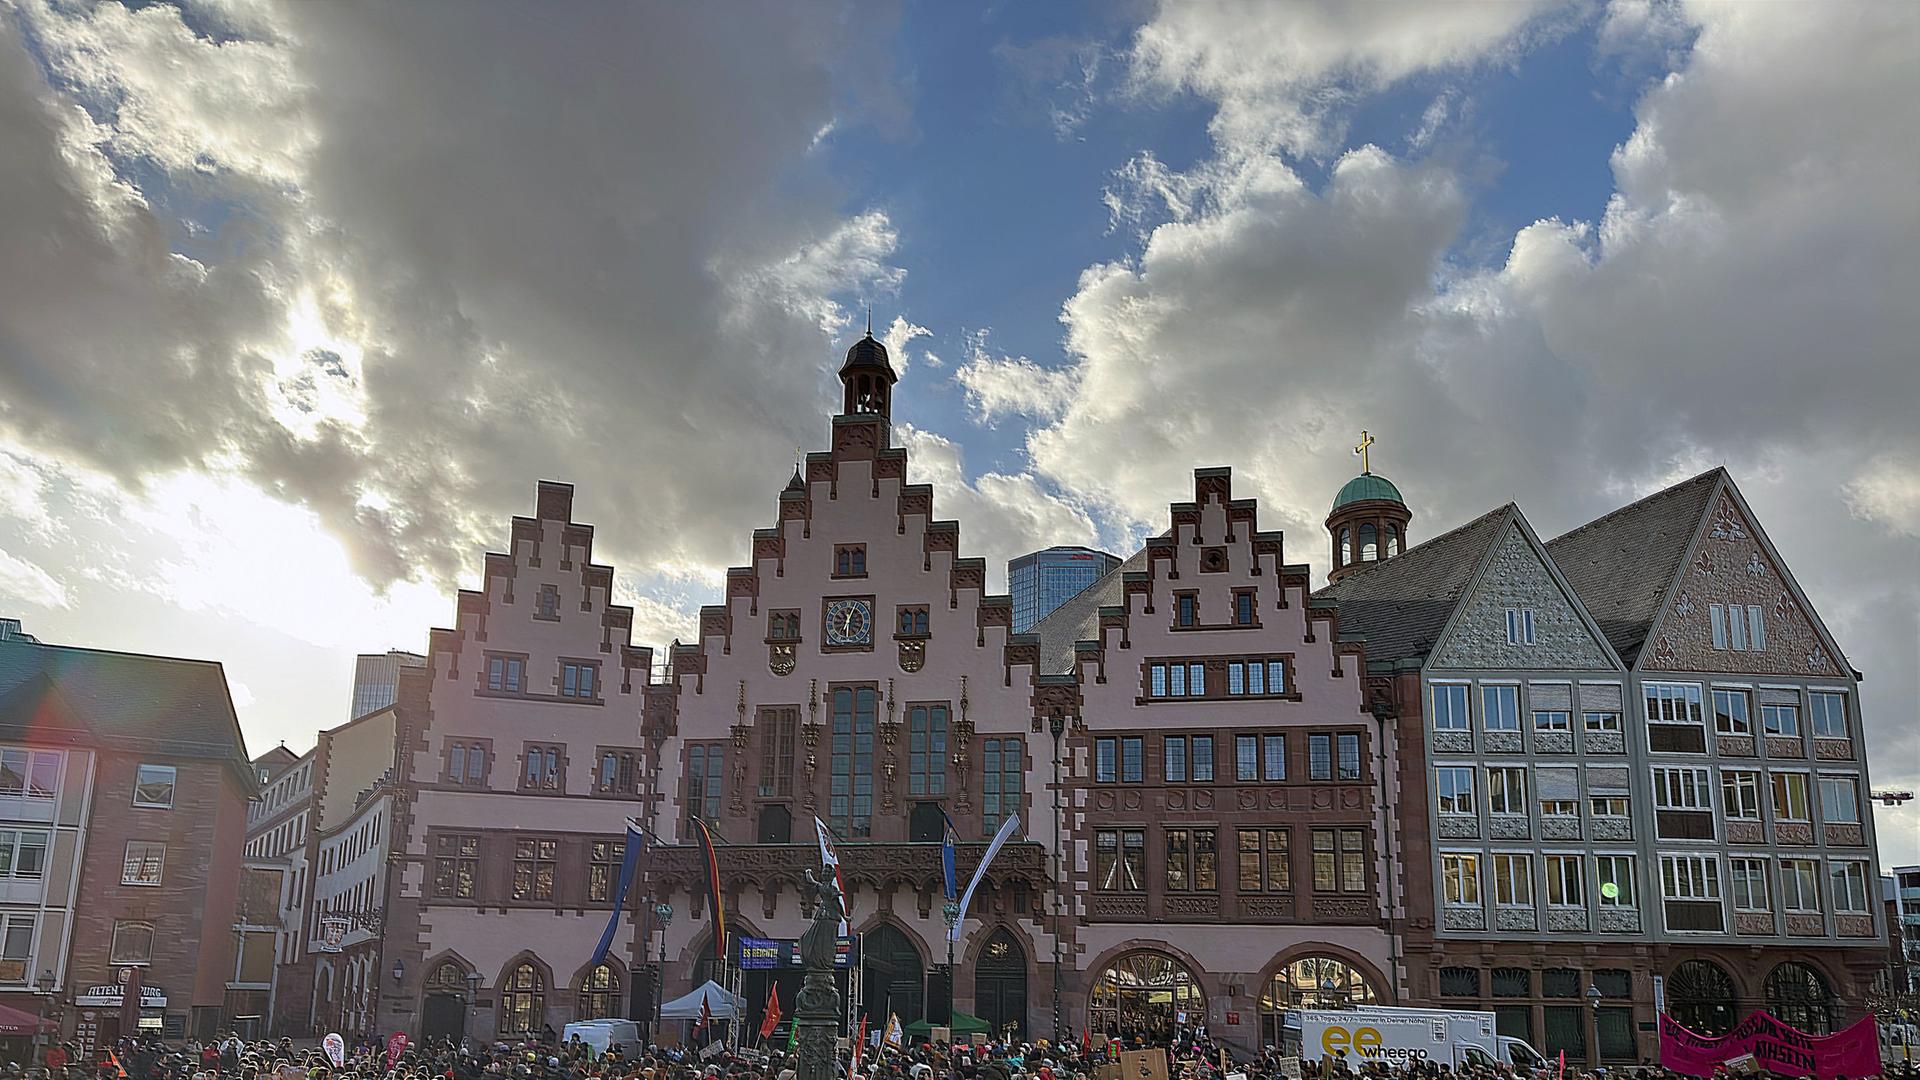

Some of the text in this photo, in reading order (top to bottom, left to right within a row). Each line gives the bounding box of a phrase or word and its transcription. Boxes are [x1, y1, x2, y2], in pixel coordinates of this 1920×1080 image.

[743, 949, 751, 958] ES
[88, 985, 118, 996] ALTEN
[1363, 1044, 1428, 1059] wheego
